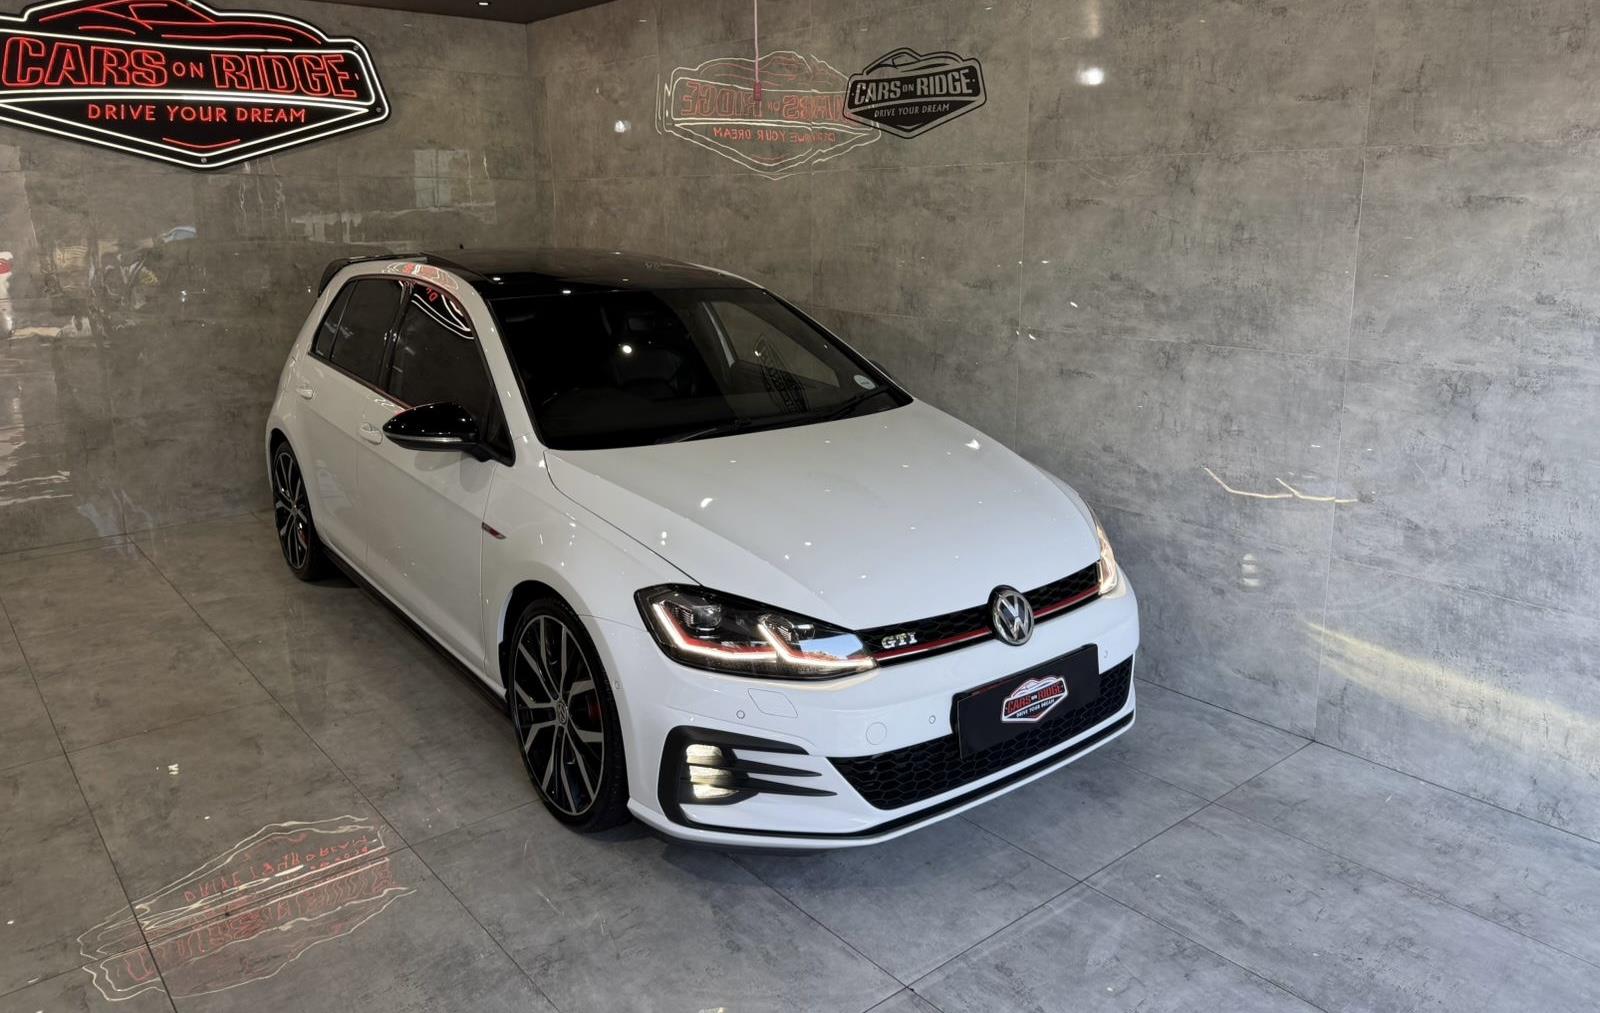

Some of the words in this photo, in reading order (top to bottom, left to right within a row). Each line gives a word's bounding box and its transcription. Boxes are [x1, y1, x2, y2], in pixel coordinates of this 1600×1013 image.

[1, 36, 168, 88] CARS
[172, 62, 204, 79] ON
[210, 53, 358, 99] RIDGE
[854, 80, 901, 105] CARS
[902, 83, 914, 93] ON
[916, 68, 973, 96] RIDGE
[87, 103, 157, 122] DRIVE
[166, 104, 228, 123] YOUR
[235, 106, 307, 125] DREAM
[873, 107, 896, 118] DRIVE
[898, 105, 920, 116] YOUR
[921, 103, 951, 114] DREAM
[881, 631, 919, 650] GTI
[1007, 695, 1031, 713] CARS
